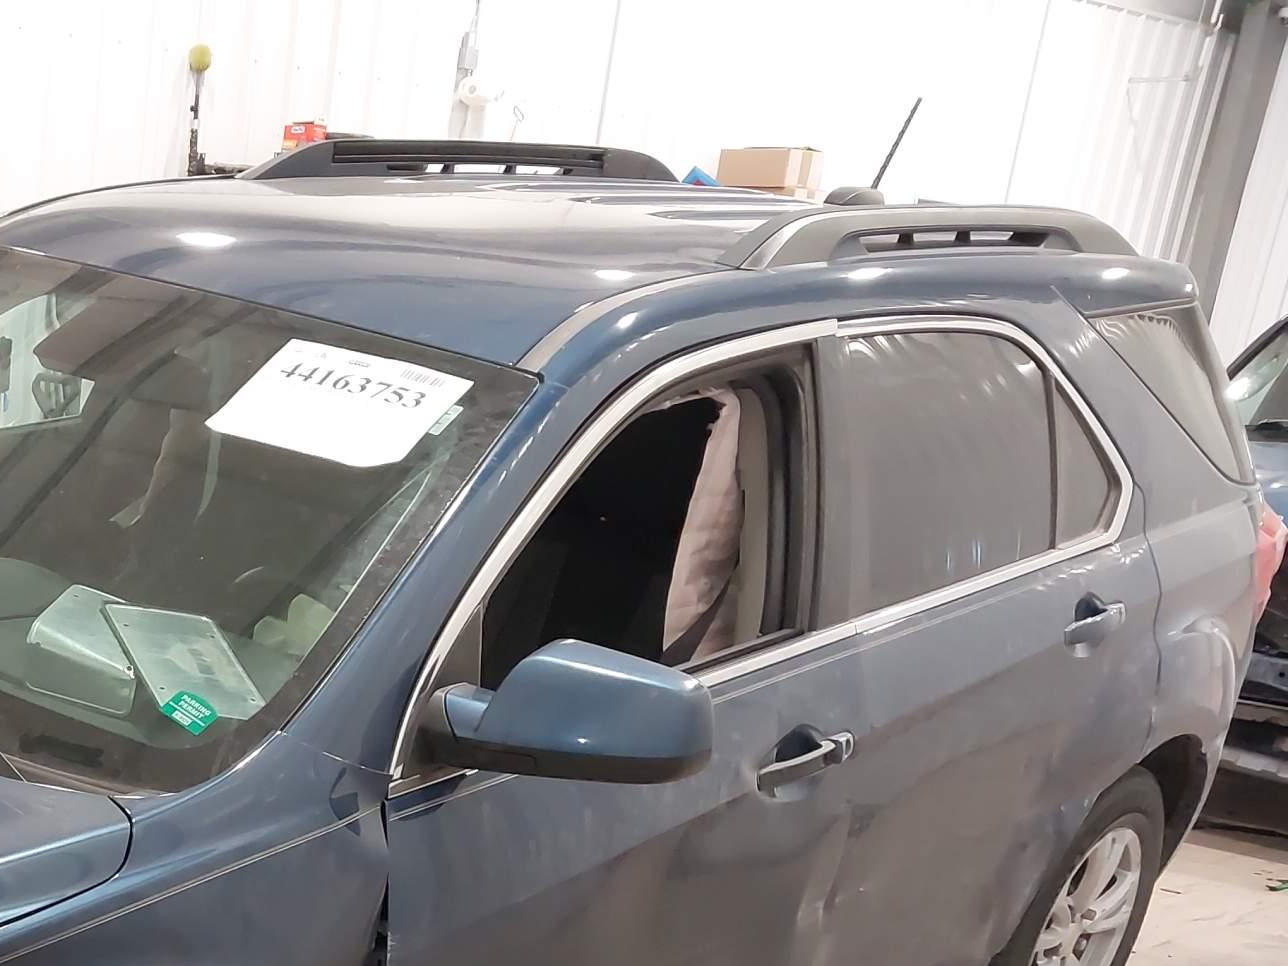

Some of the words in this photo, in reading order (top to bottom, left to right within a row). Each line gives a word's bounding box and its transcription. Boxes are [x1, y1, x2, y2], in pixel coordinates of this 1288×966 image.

[280, 362, 427, 409] 44163753
[178, 700, 204, 719] PERMIT
[181, 694, 212, 716] PARKING
